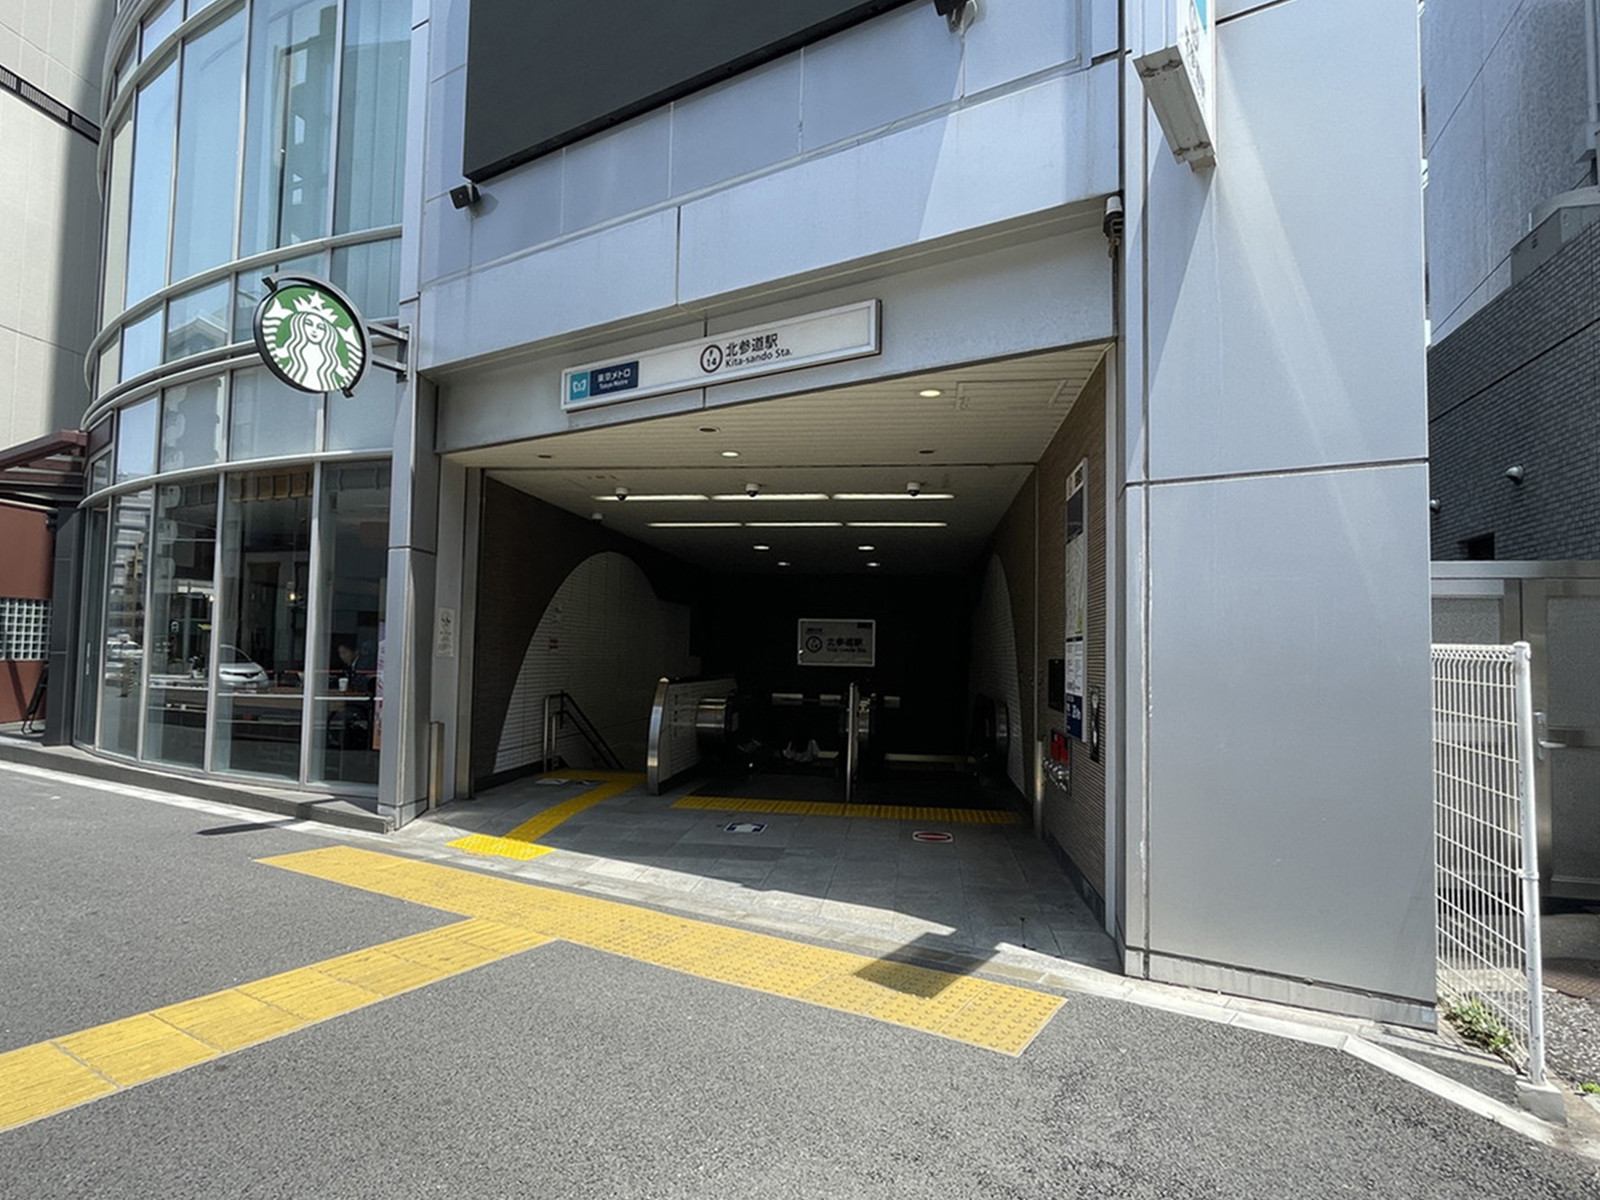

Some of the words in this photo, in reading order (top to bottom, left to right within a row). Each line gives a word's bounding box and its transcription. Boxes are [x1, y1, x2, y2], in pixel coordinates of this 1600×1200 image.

[725, 333, 778, 358] 北参道駅
[725, 351, 773, 368] Kita-sando
[775, 348, 792, 358] Sta.
